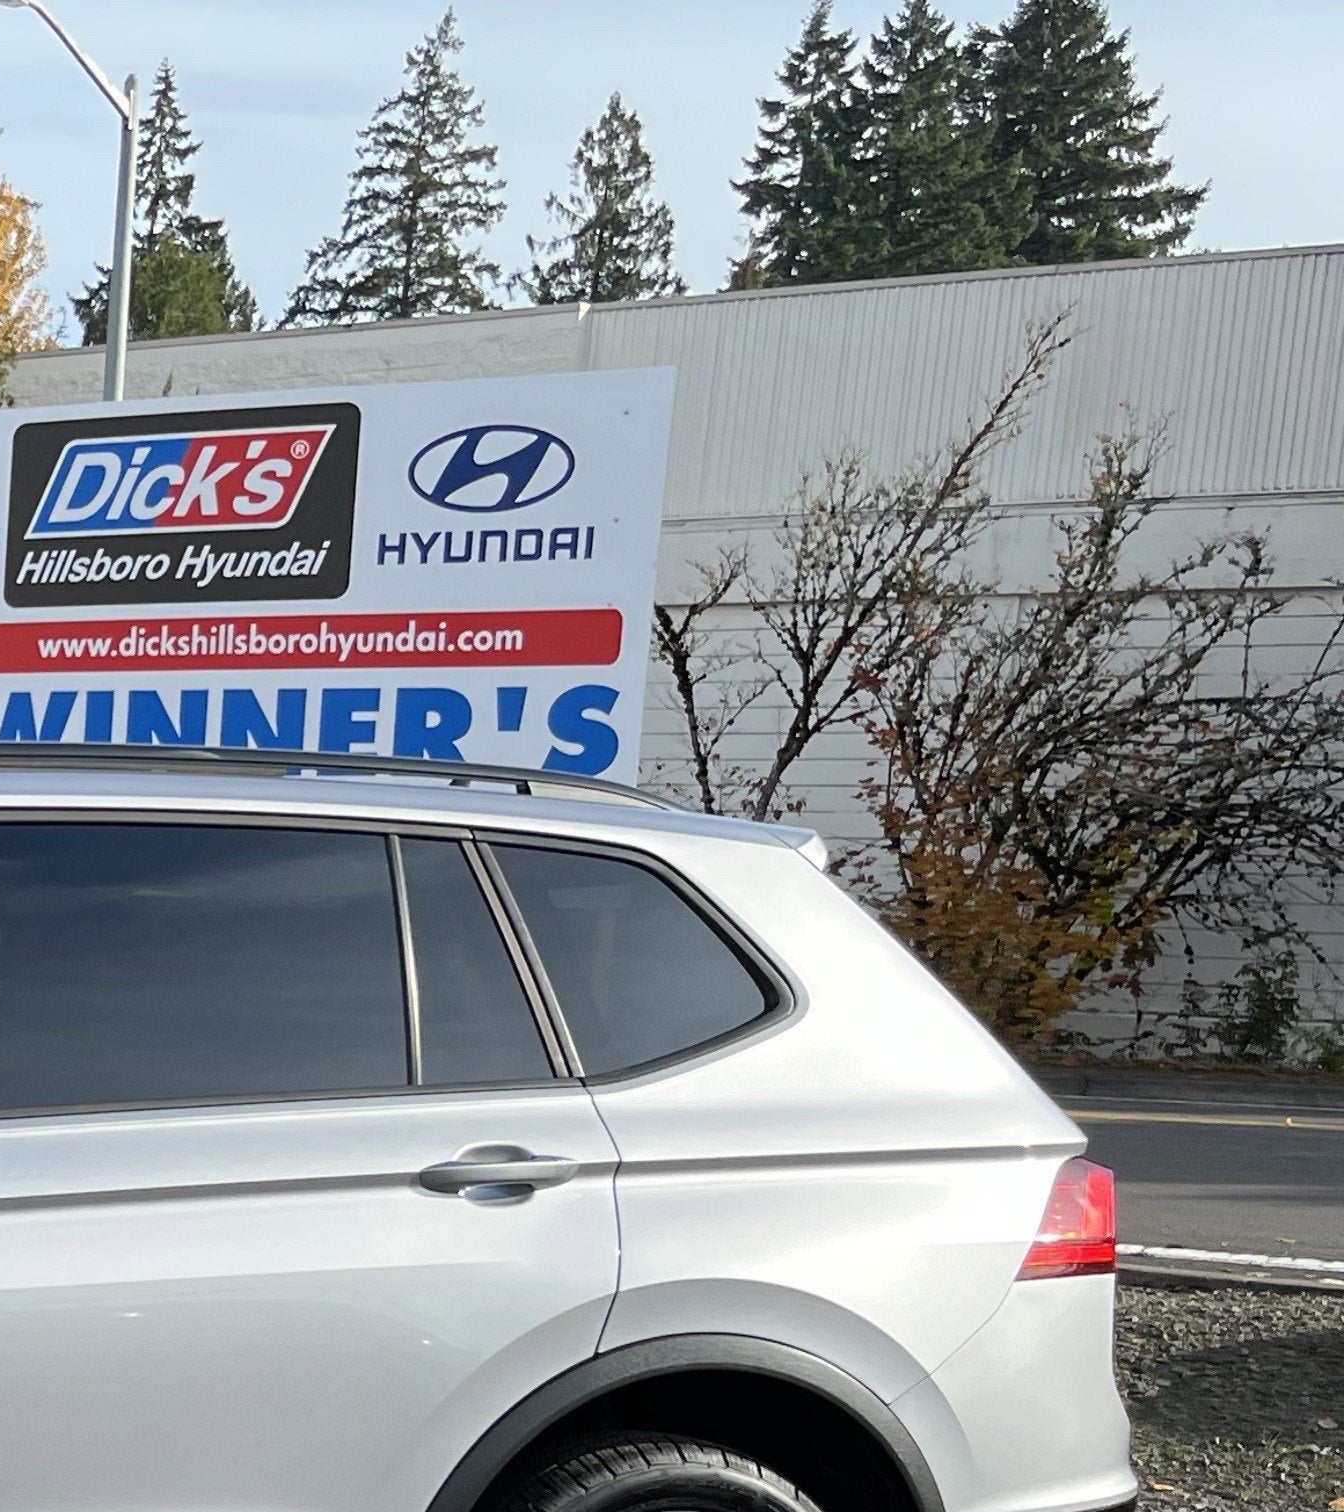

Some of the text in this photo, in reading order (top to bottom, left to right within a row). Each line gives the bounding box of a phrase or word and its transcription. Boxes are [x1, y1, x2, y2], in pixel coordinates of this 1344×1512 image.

[48, 440, 293, 523] Dick's
[15, 540, 332, 588] Hillsboro Hyundai
[376, 526, 595, 565] HYUNDAI
[37, 619, 524, 663] www.dickshillsborohyundai.com
